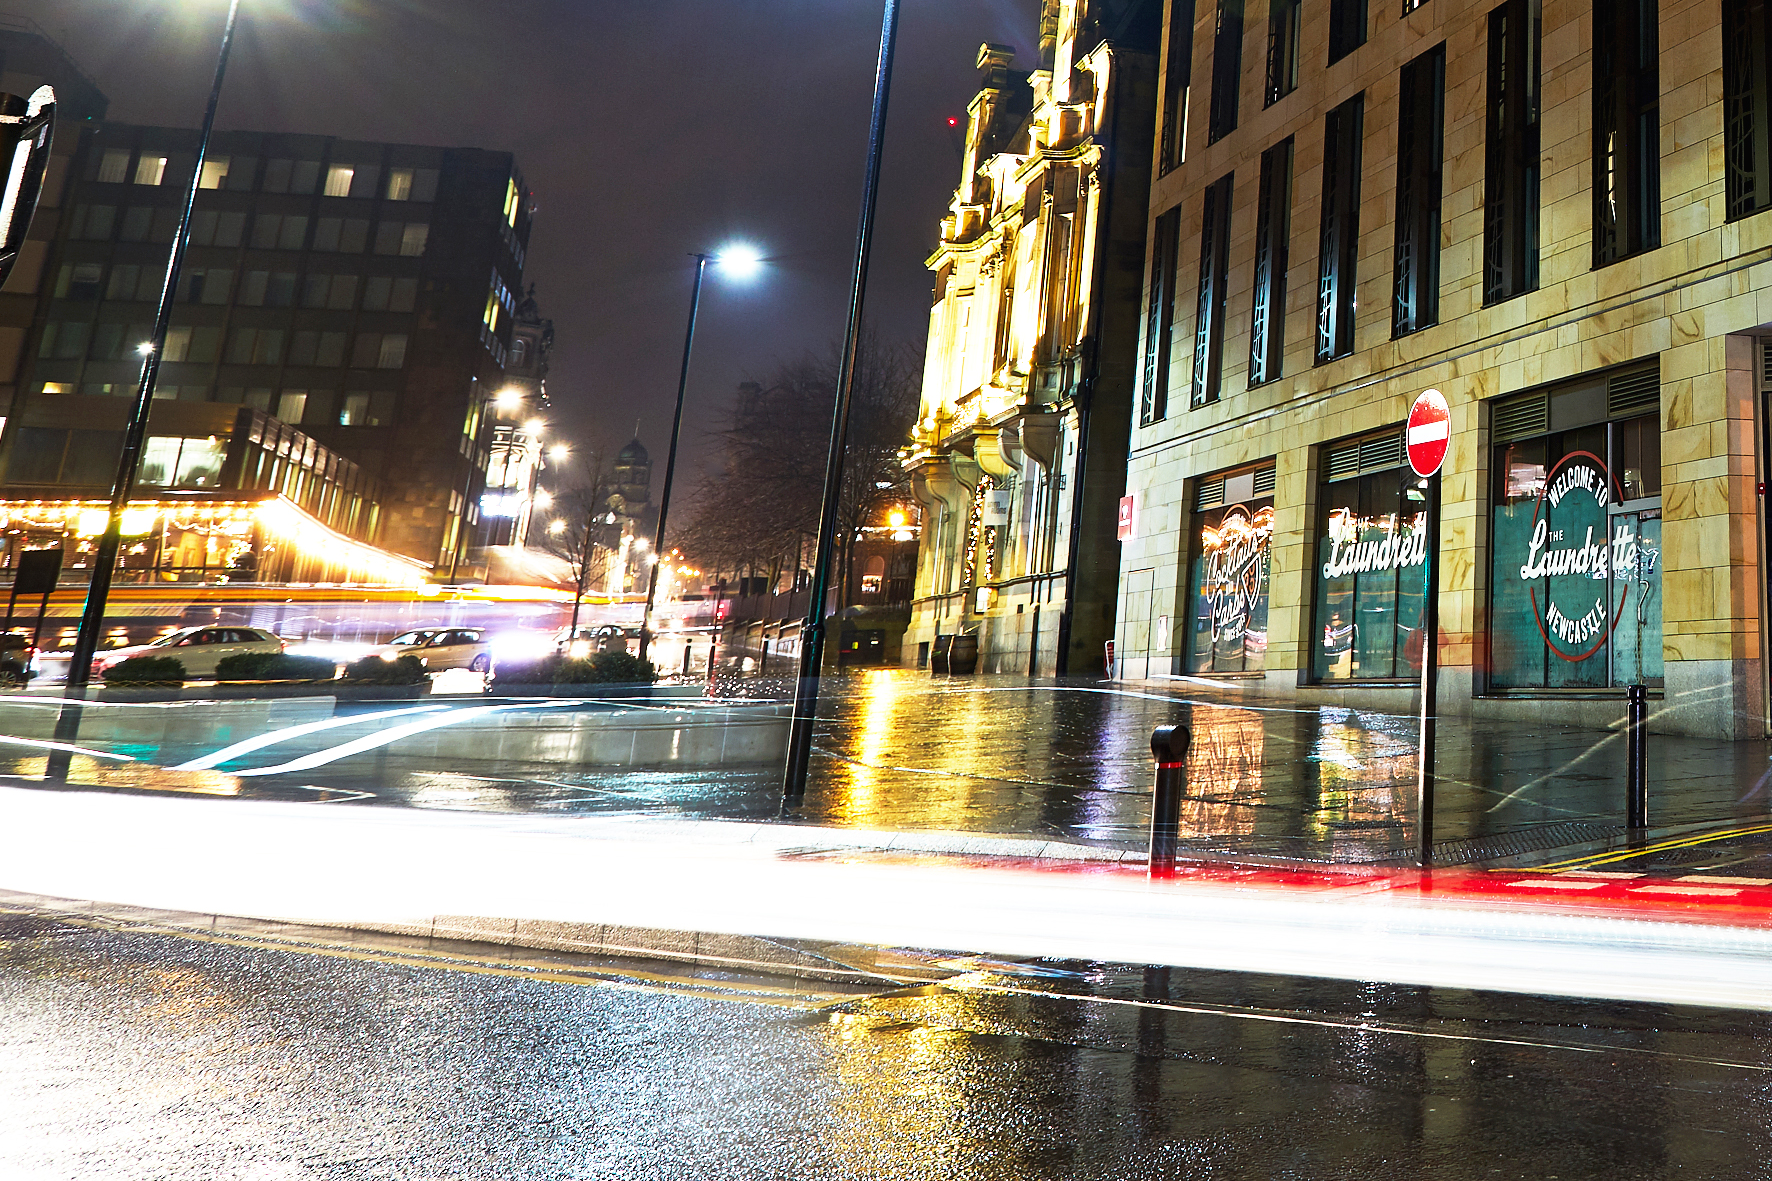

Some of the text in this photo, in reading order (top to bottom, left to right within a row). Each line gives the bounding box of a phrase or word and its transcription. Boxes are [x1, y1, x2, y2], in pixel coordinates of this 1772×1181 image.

[1548, 465, 1608, 509] WELCOME TO
[1323, 507, 1428, 580] Laundrett
[1520, 519, 1638, 580] Laundrette
[1549, 529, 1564, 542] THE
[1546, 598, 1607, 644] NEWCASTLE
